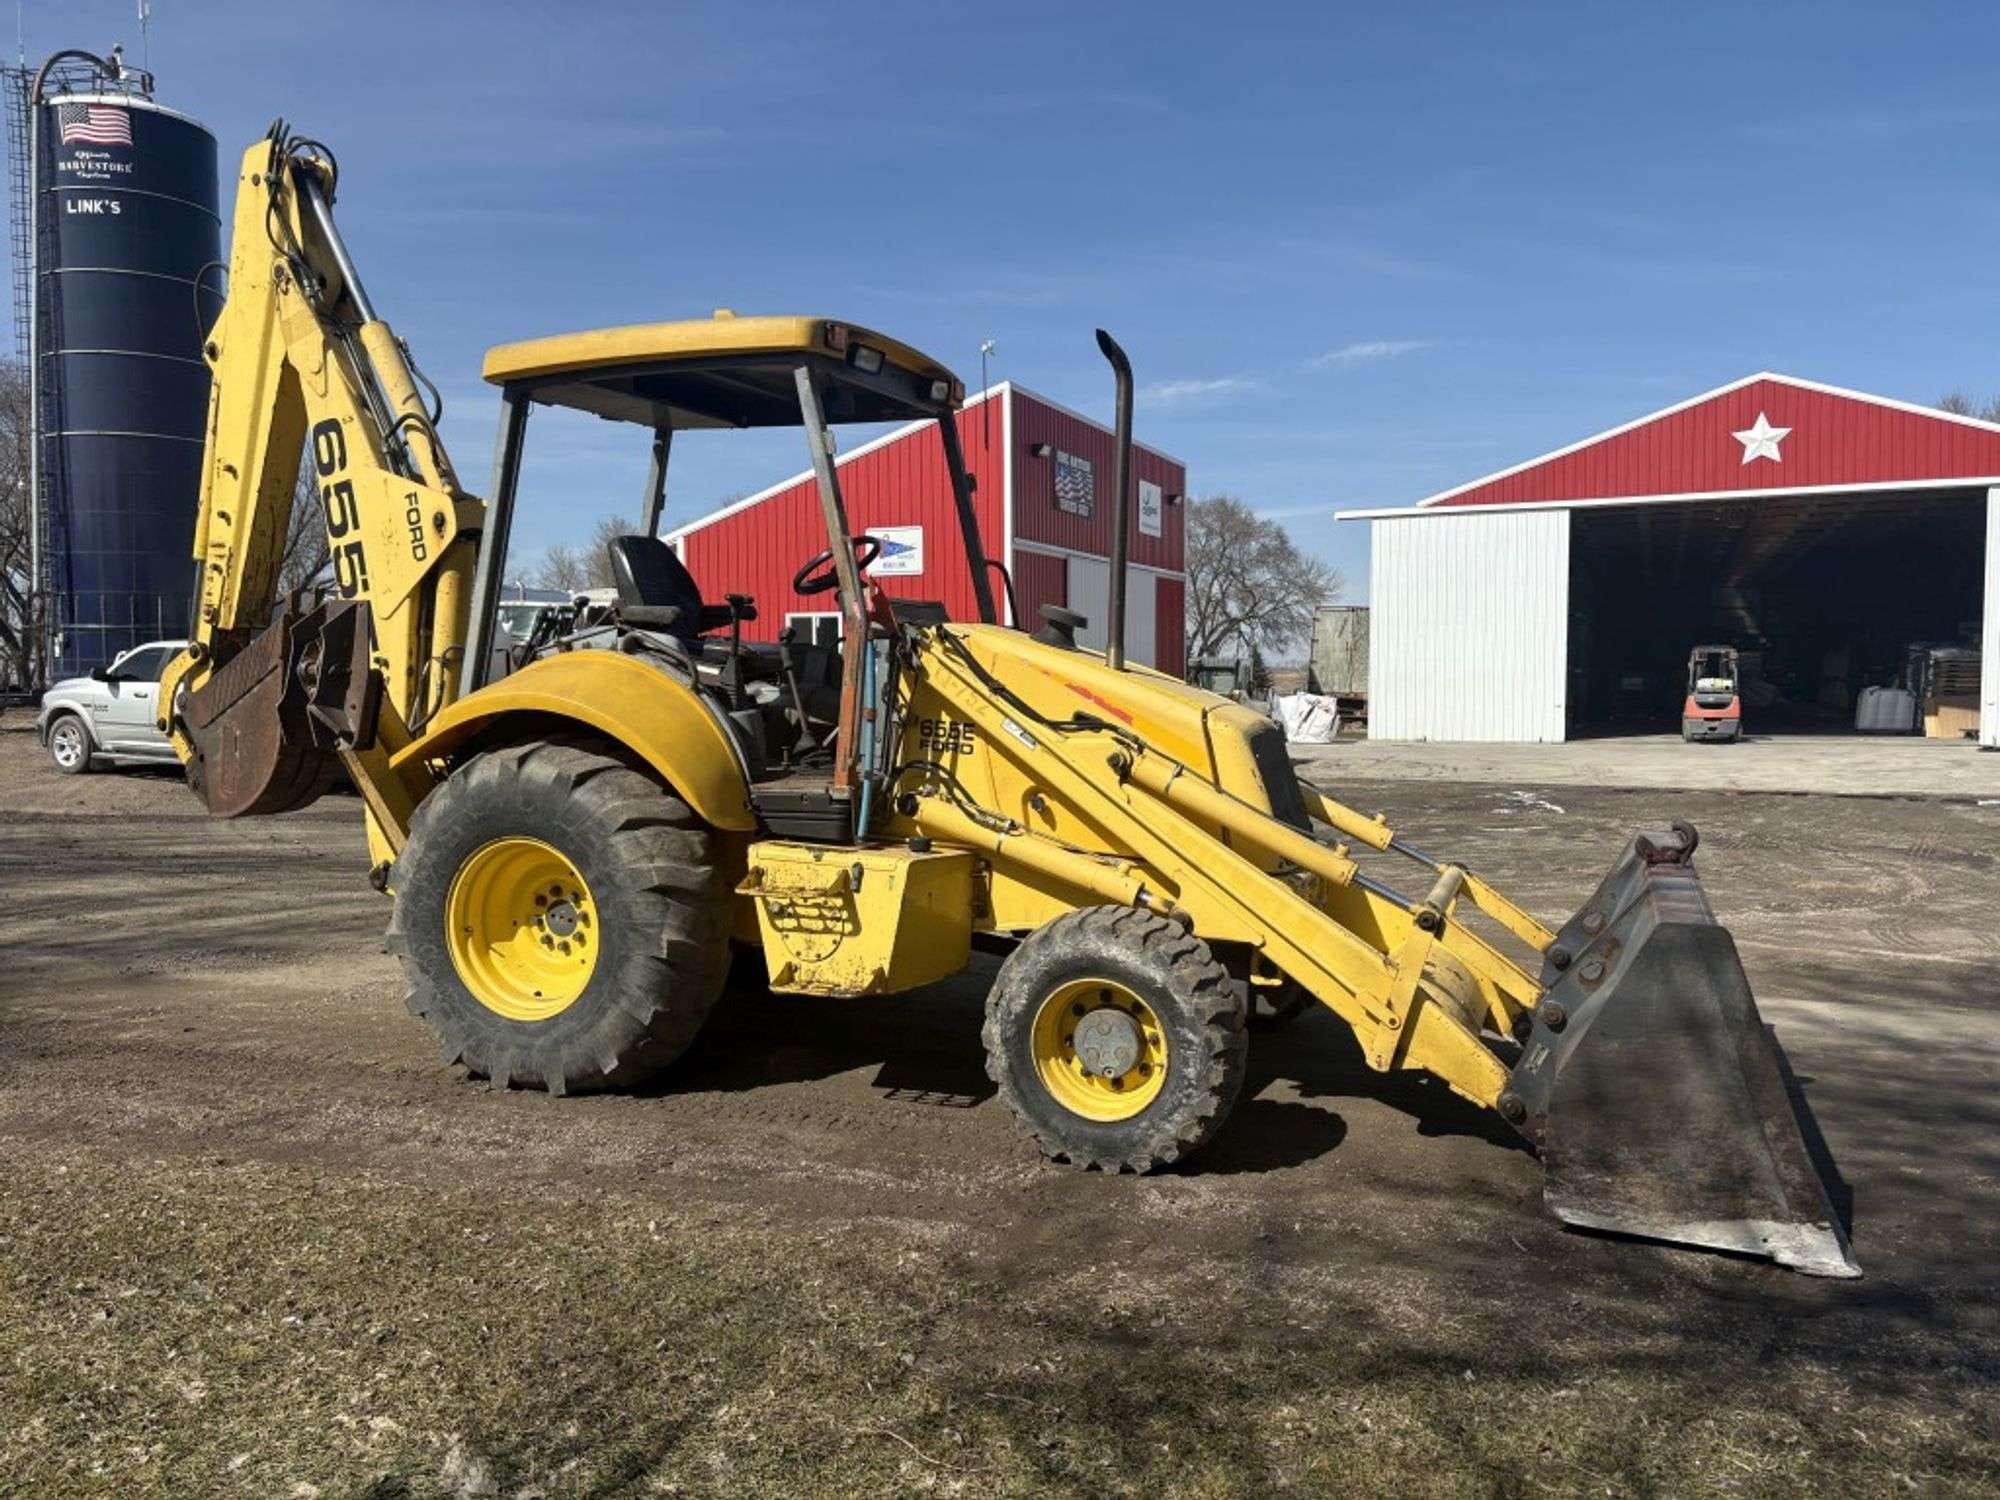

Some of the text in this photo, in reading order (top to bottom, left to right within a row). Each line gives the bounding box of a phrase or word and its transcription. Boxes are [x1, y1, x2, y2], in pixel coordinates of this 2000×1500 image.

[66, 199, 121, 214] LINK'S
[404, 492, 427, 562] FORD
[920, 719, 976, 740] 655E
[919, 740, 974, 755] FORD
